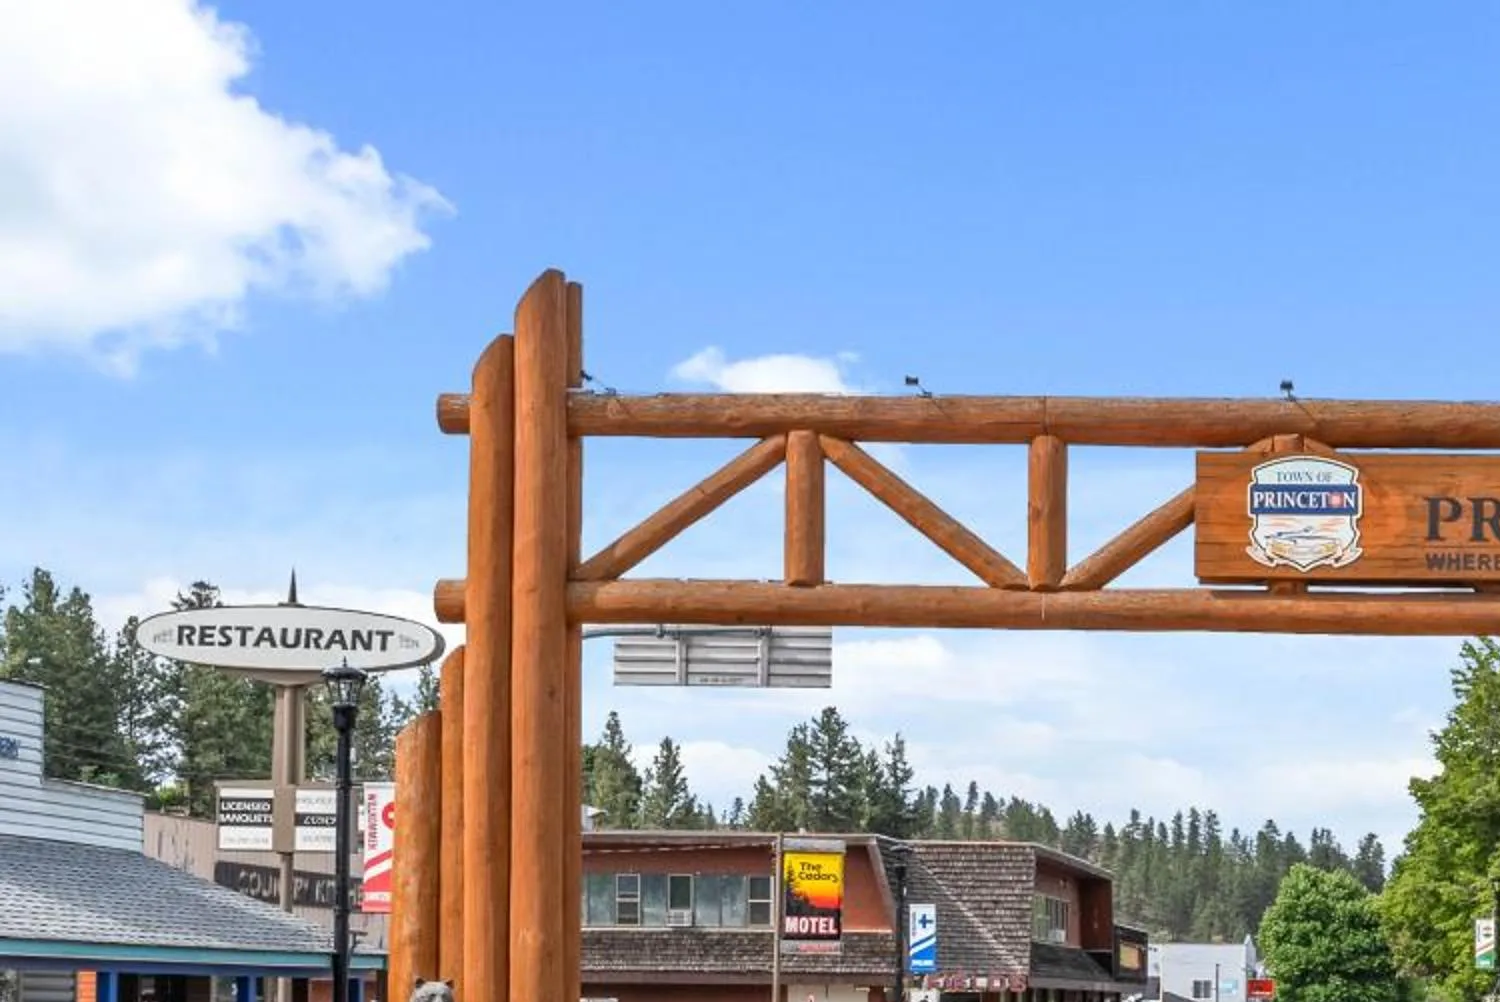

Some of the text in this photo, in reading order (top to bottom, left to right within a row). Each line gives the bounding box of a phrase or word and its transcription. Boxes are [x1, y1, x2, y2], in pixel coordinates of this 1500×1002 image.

[1277, 471, 1333, 482] TOWN OF
[177, 625, 395, 651] RESTAURANT
[799, 861, 823, 871] The
[798, 870, 840, 884] Cedars
[785, 916, 838, 935] MOTEL
